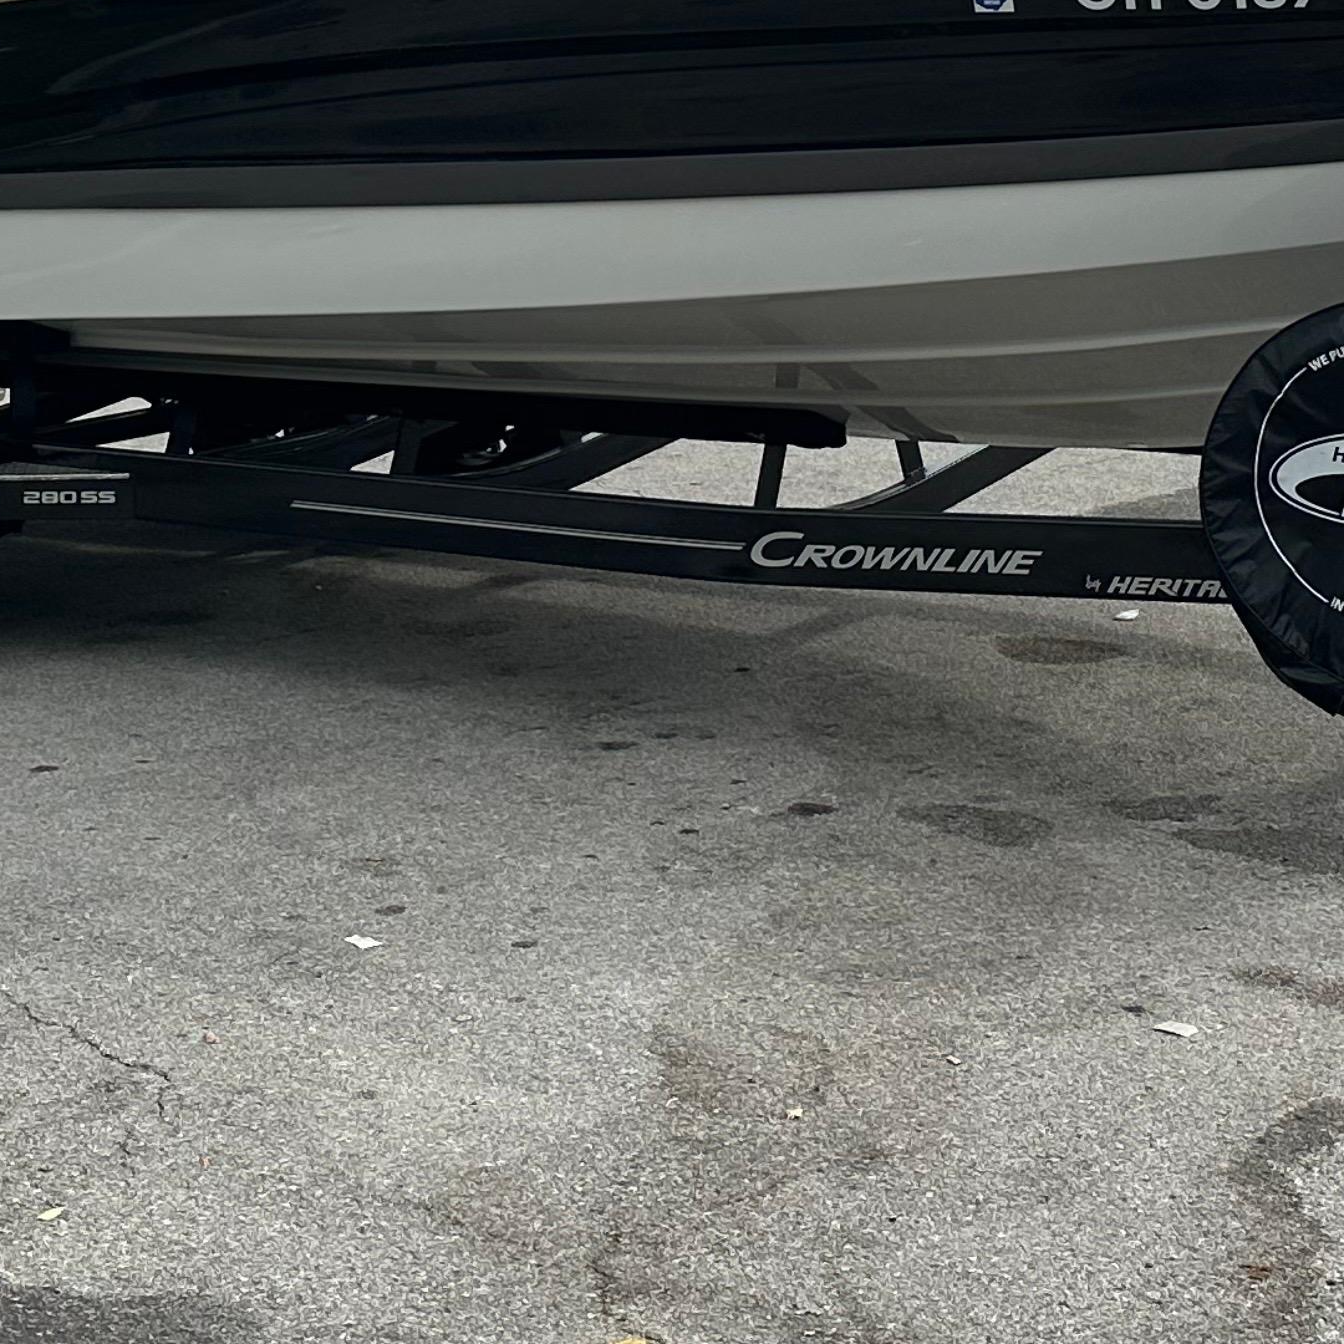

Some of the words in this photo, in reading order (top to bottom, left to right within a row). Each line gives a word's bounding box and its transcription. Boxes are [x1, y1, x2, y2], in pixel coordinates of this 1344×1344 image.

[1308, 354, 1330, 372] WE
[750, 531, 1044, 576] CROWNLINE
[1107, 576, 1228, 599] HERITA
[1330, 596, 1344, 612] IN
